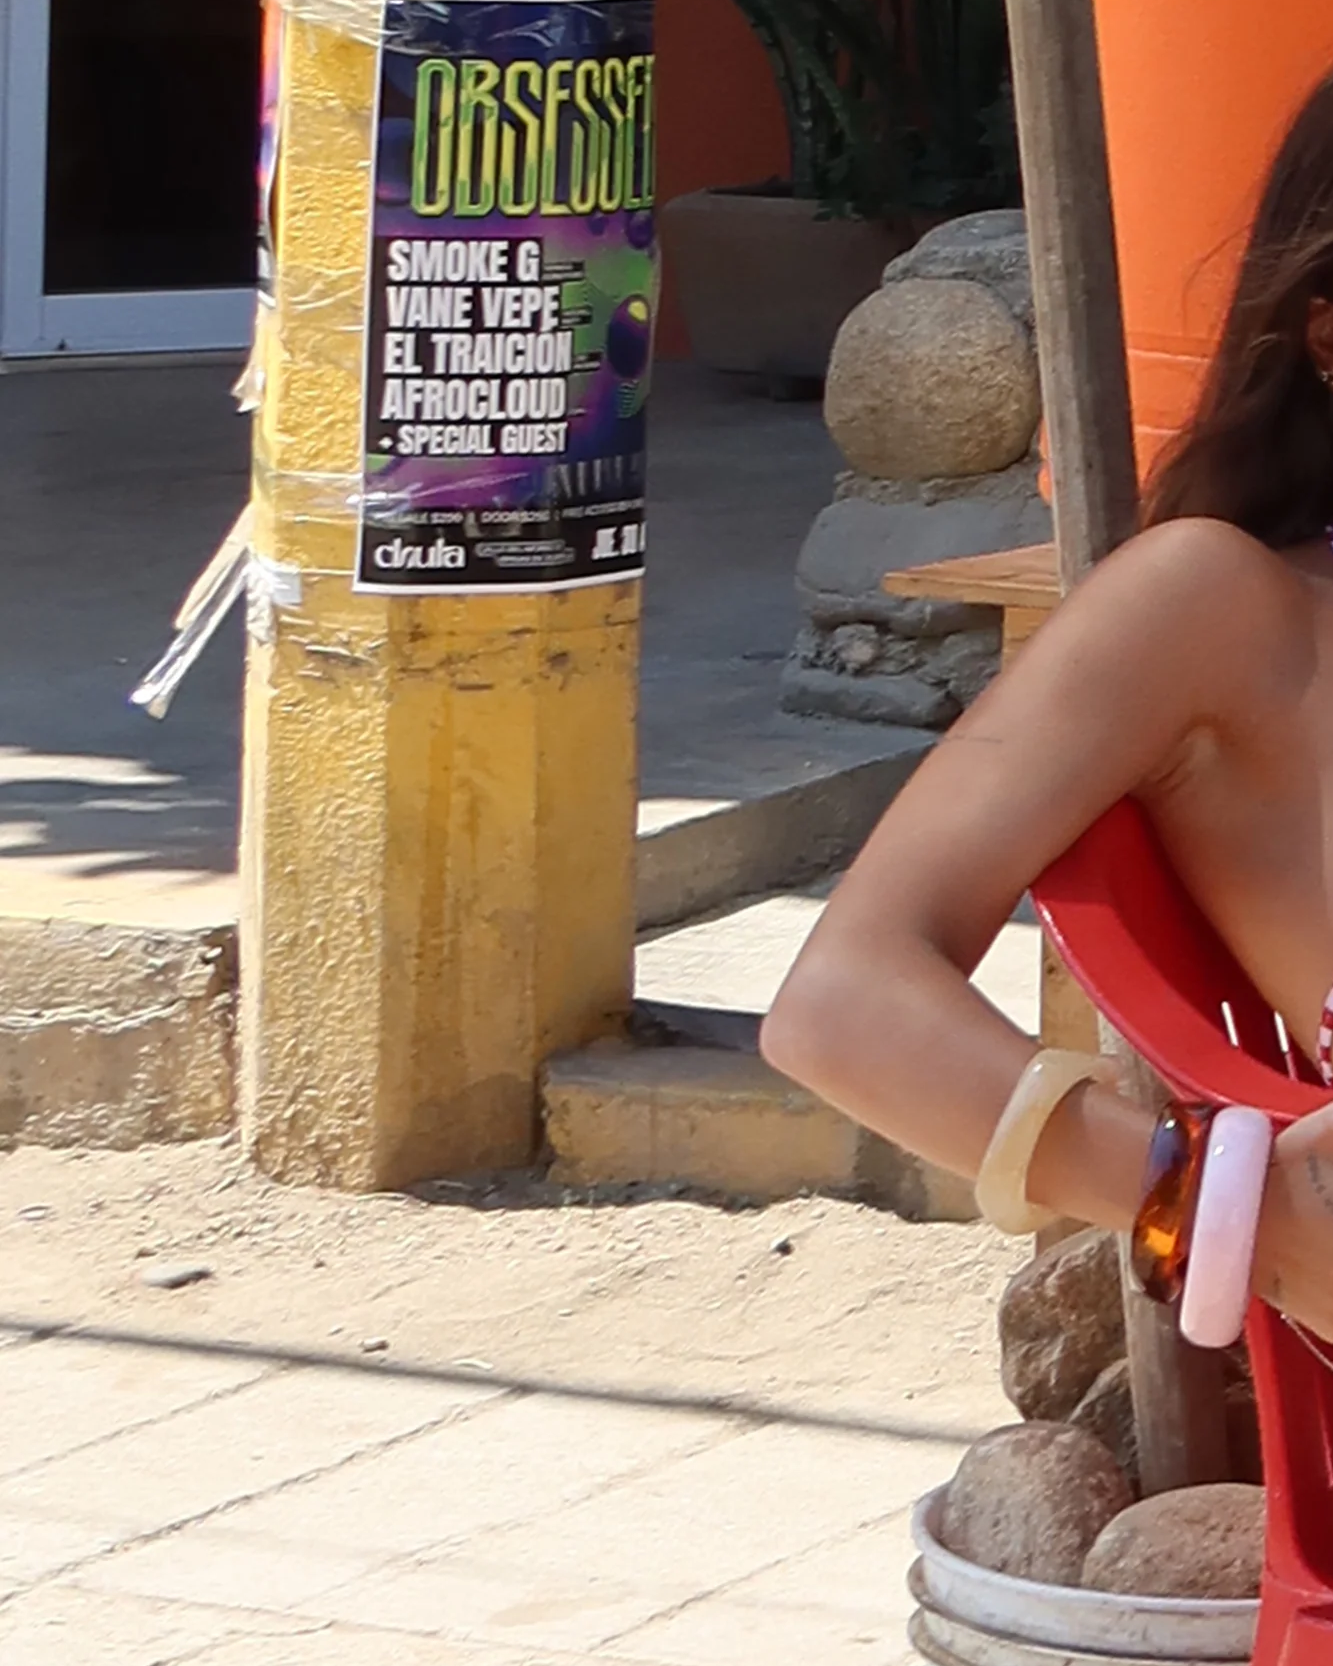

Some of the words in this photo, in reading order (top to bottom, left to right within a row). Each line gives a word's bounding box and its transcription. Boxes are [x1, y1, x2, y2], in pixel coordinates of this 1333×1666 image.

[387, 240, 509, 283] SMOKE
[516, 240, 542, 283] G
[386, 286, 474, 329] VANE
[480, 285, 561, 331] VEPE
[382, 332, 423, 375] EL
[379, 377, 568, 422] AFROCLOUD
[396, 424, 496, 455] SPECIAL
[500, 421, 568, 455] GUEST
